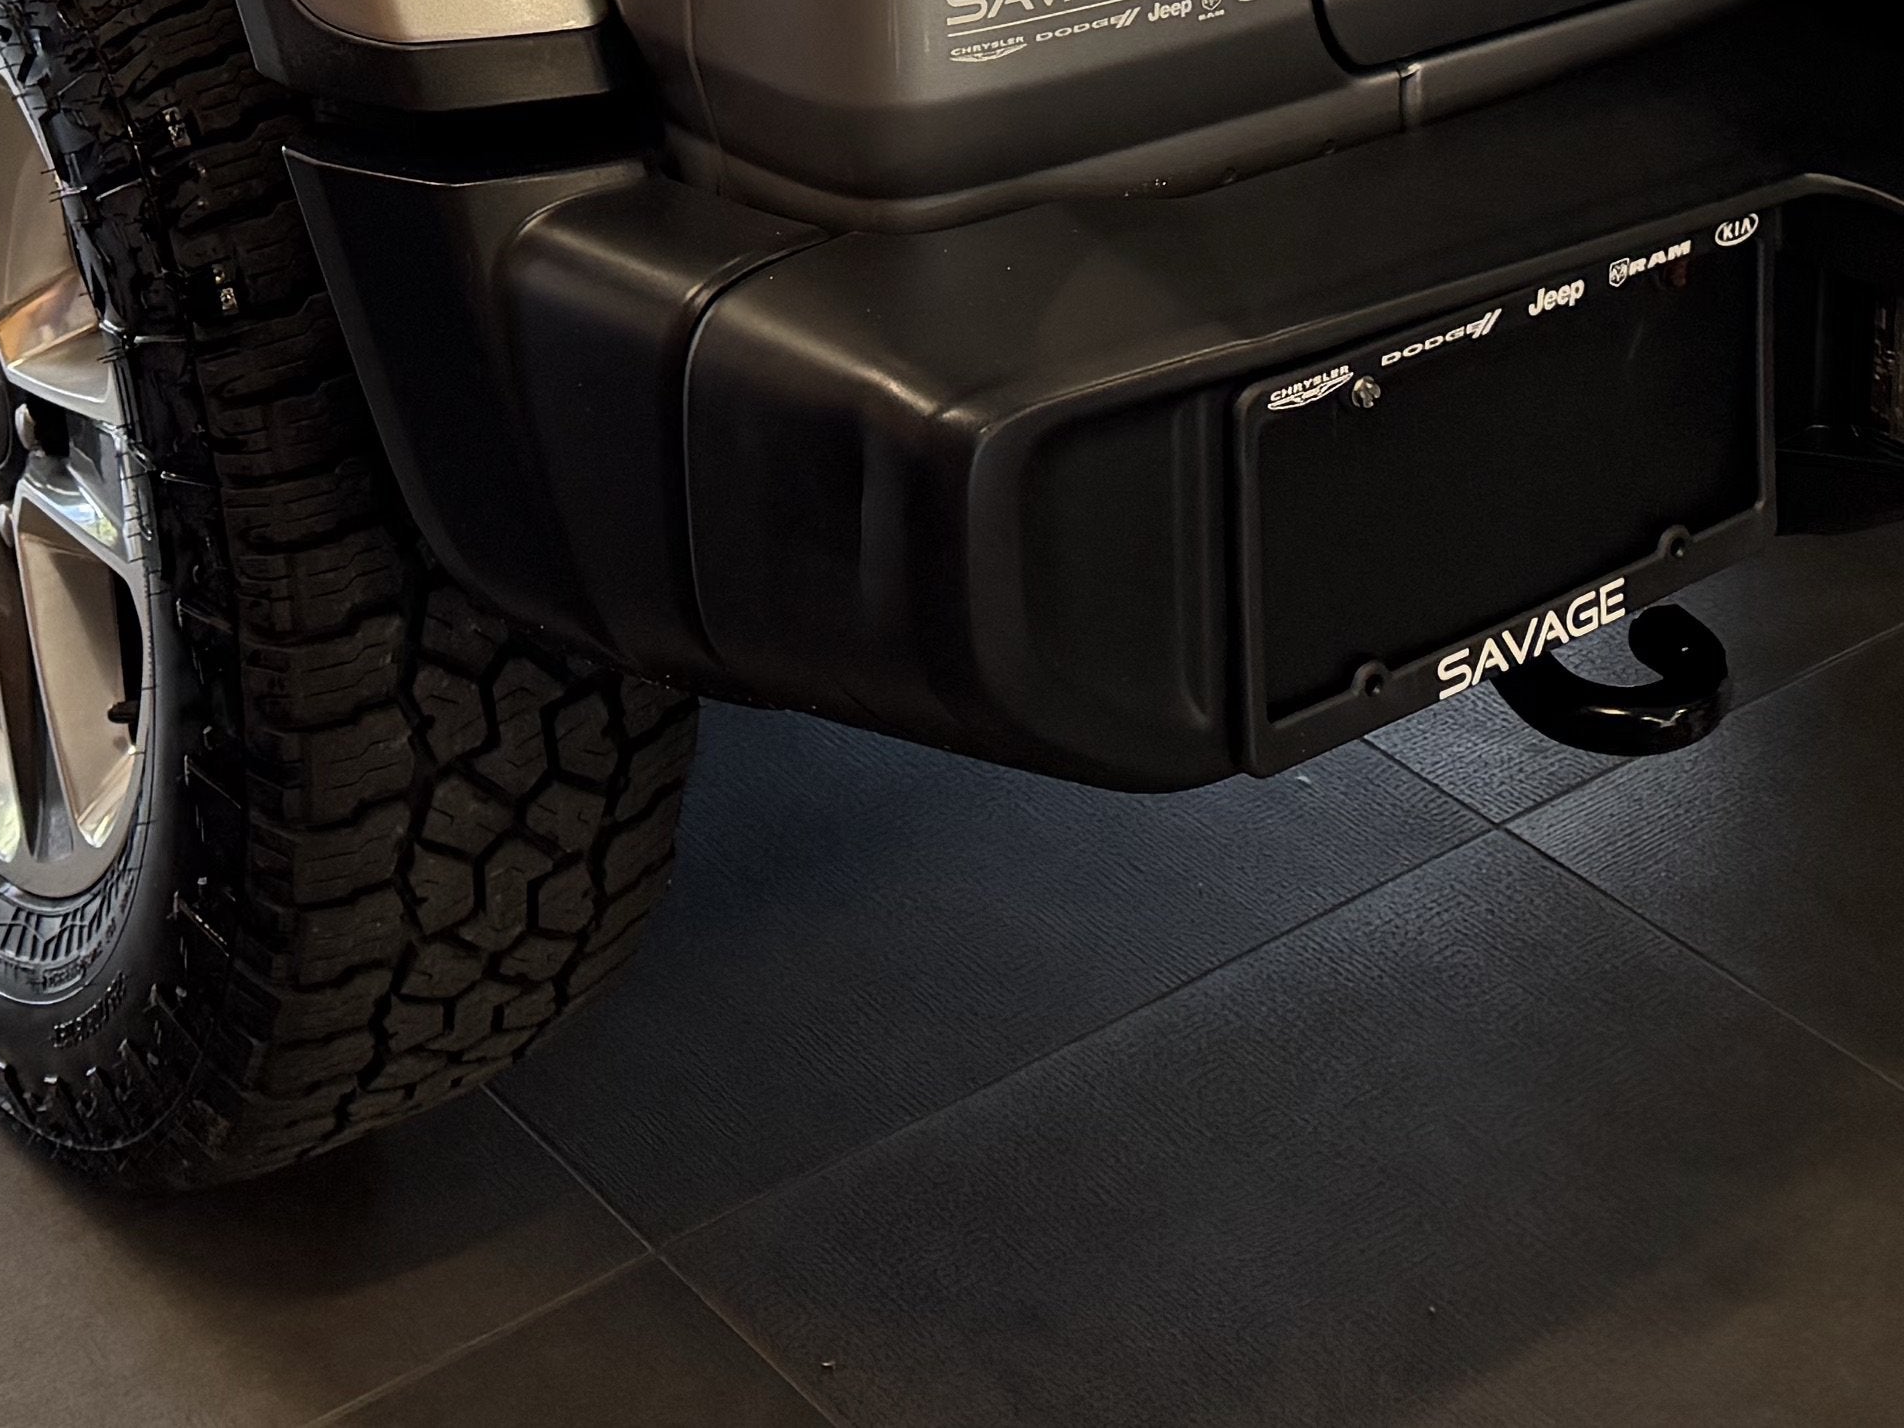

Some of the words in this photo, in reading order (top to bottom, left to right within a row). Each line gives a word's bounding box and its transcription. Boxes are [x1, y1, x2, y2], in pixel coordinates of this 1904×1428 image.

[950, 36, 1025, 57] CHRYSLER
[1147, 0, 1192, 22] Jeep
[1270, 365, 1350, 402] CHRYSLER
[1528, 279, 1585, 316] Jeep
[1628, 240, 1692, 276] RAM
[1720, 216, 1754, 241] KIA
[1437, 577, 1626, 700] SAVAGE
